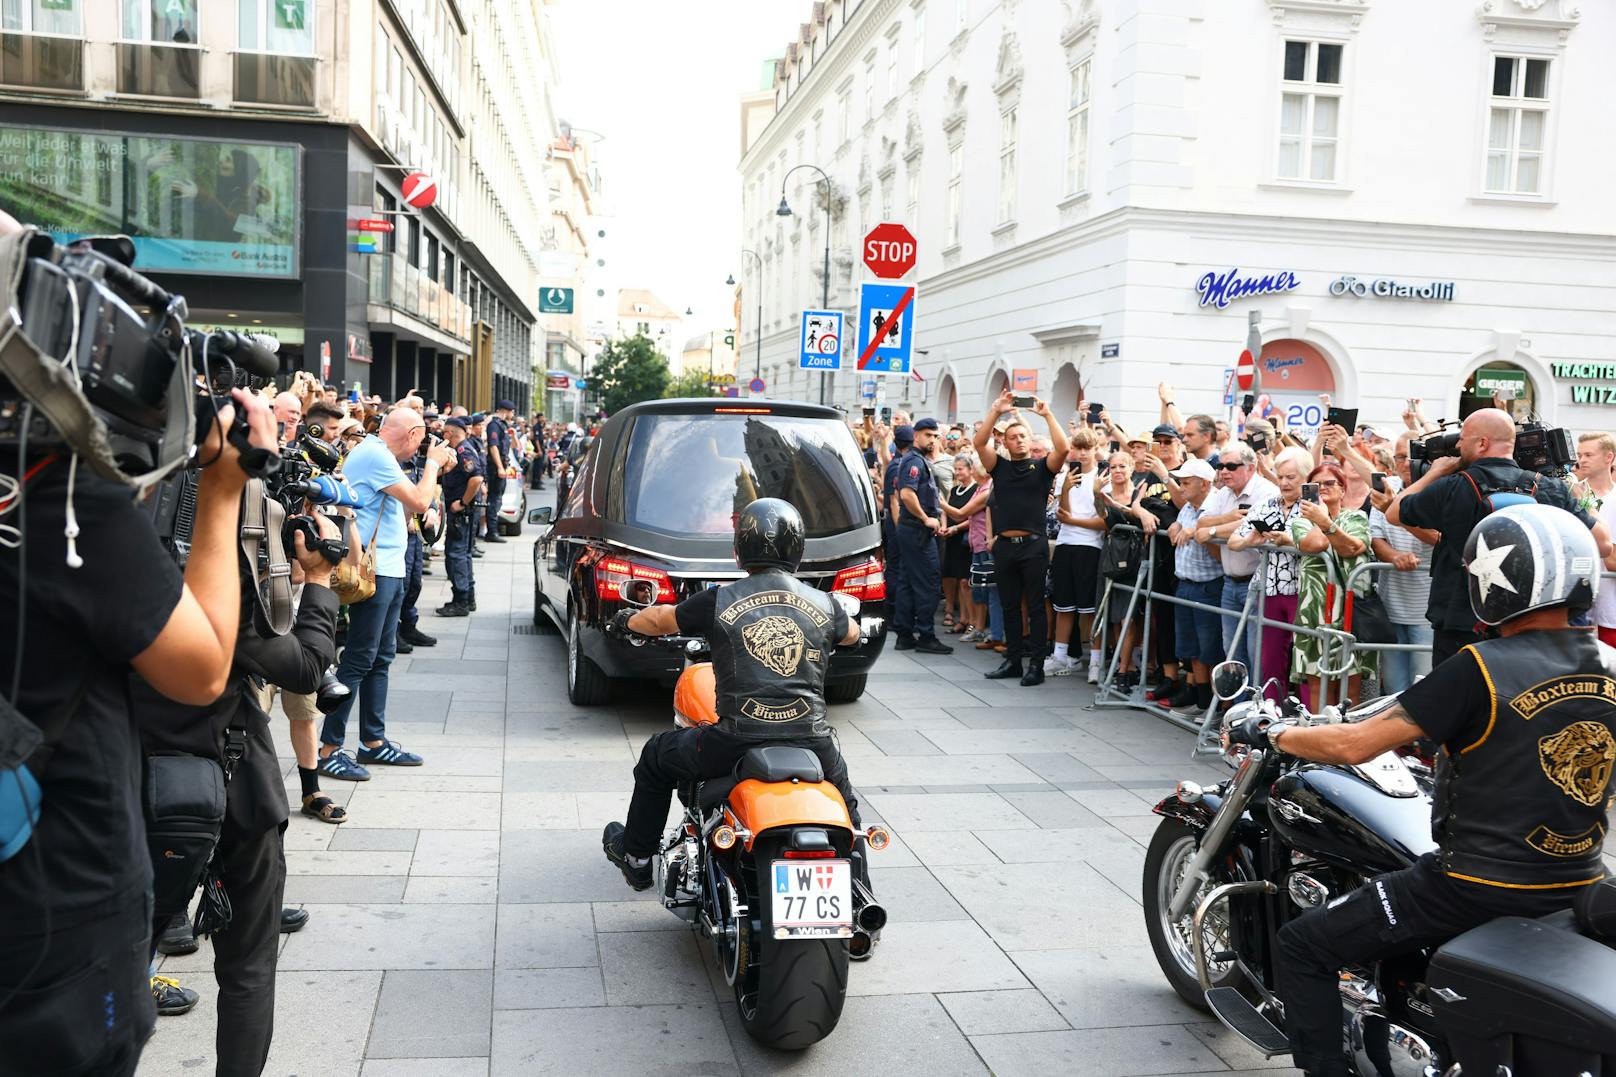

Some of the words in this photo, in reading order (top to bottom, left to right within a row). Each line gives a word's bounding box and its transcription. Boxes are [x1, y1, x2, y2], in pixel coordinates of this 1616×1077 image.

[82, 142, 128, 156] etwas
[55, 154, 118, 172] Umwelt
[866, 239, 914, 263] STOP
[1198, 267, 1301, 307] Manner
[823, 340, 836, 352] 20
[807, 355, 834, 368] Zone
[1264, 358, 1304, 373] Manner
[1477, 379, 1525, 390] GEIGER
[1287, 405, 1321, 427] 20
[723, 594, 780, 621] Boxteam
[784, 593, 826, 623] Riders
[1516, 681, 1599, 714] Boxteam
[753, 704, 798, 720] Vienna
[779, 882, 786, 891] A
[796, 868, 812, 891] W
[783, 896, 807, 920] 77
[816, 895, 840, 919] CS
[1382, 900, 1397, 925] SQUAD
[797, 927, 831, 935] Wien
